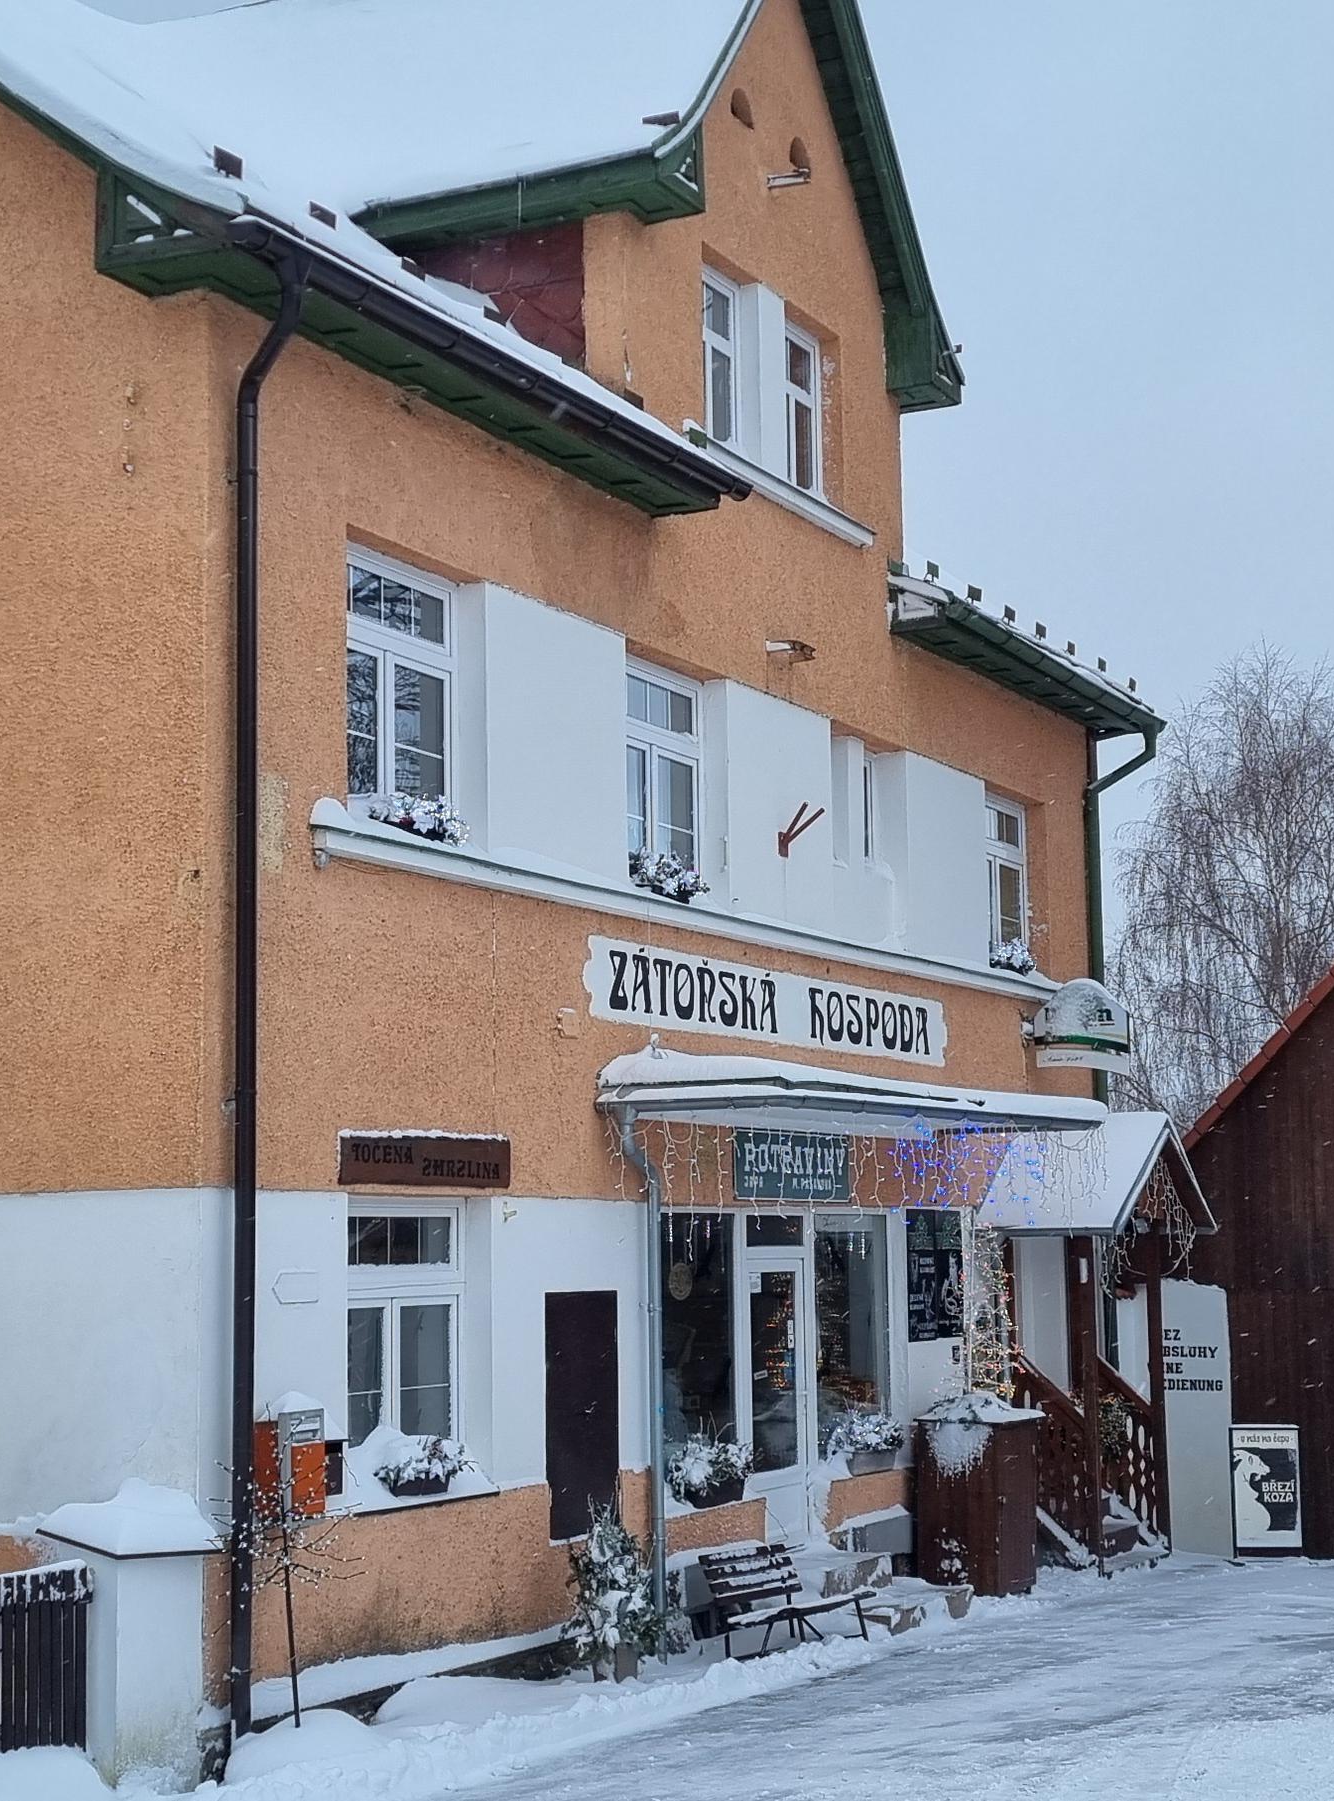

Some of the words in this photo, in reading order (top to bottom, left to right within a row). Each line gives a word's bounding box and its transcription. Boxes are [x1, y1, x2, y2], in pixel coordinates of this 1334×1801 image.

[609, 948, 778, 1034] ZÁTOŇSKÁ
[808, 987, 930, 1055] HOSPODA
[743, 1142, 845, 1176] POTRAVINY
[1163, 1328, 1181, 1341] EZ
[1163, 1345, 1218, 1358] BSLUHY
[1163, 1362, 1183, 1374] NE
[1163, 1378, 1223, 1391] DIENUNG
[1261, 1480, 1295, 1492] BŘEZÍ
[1264, 1492, 1294, 1503] KOZA
